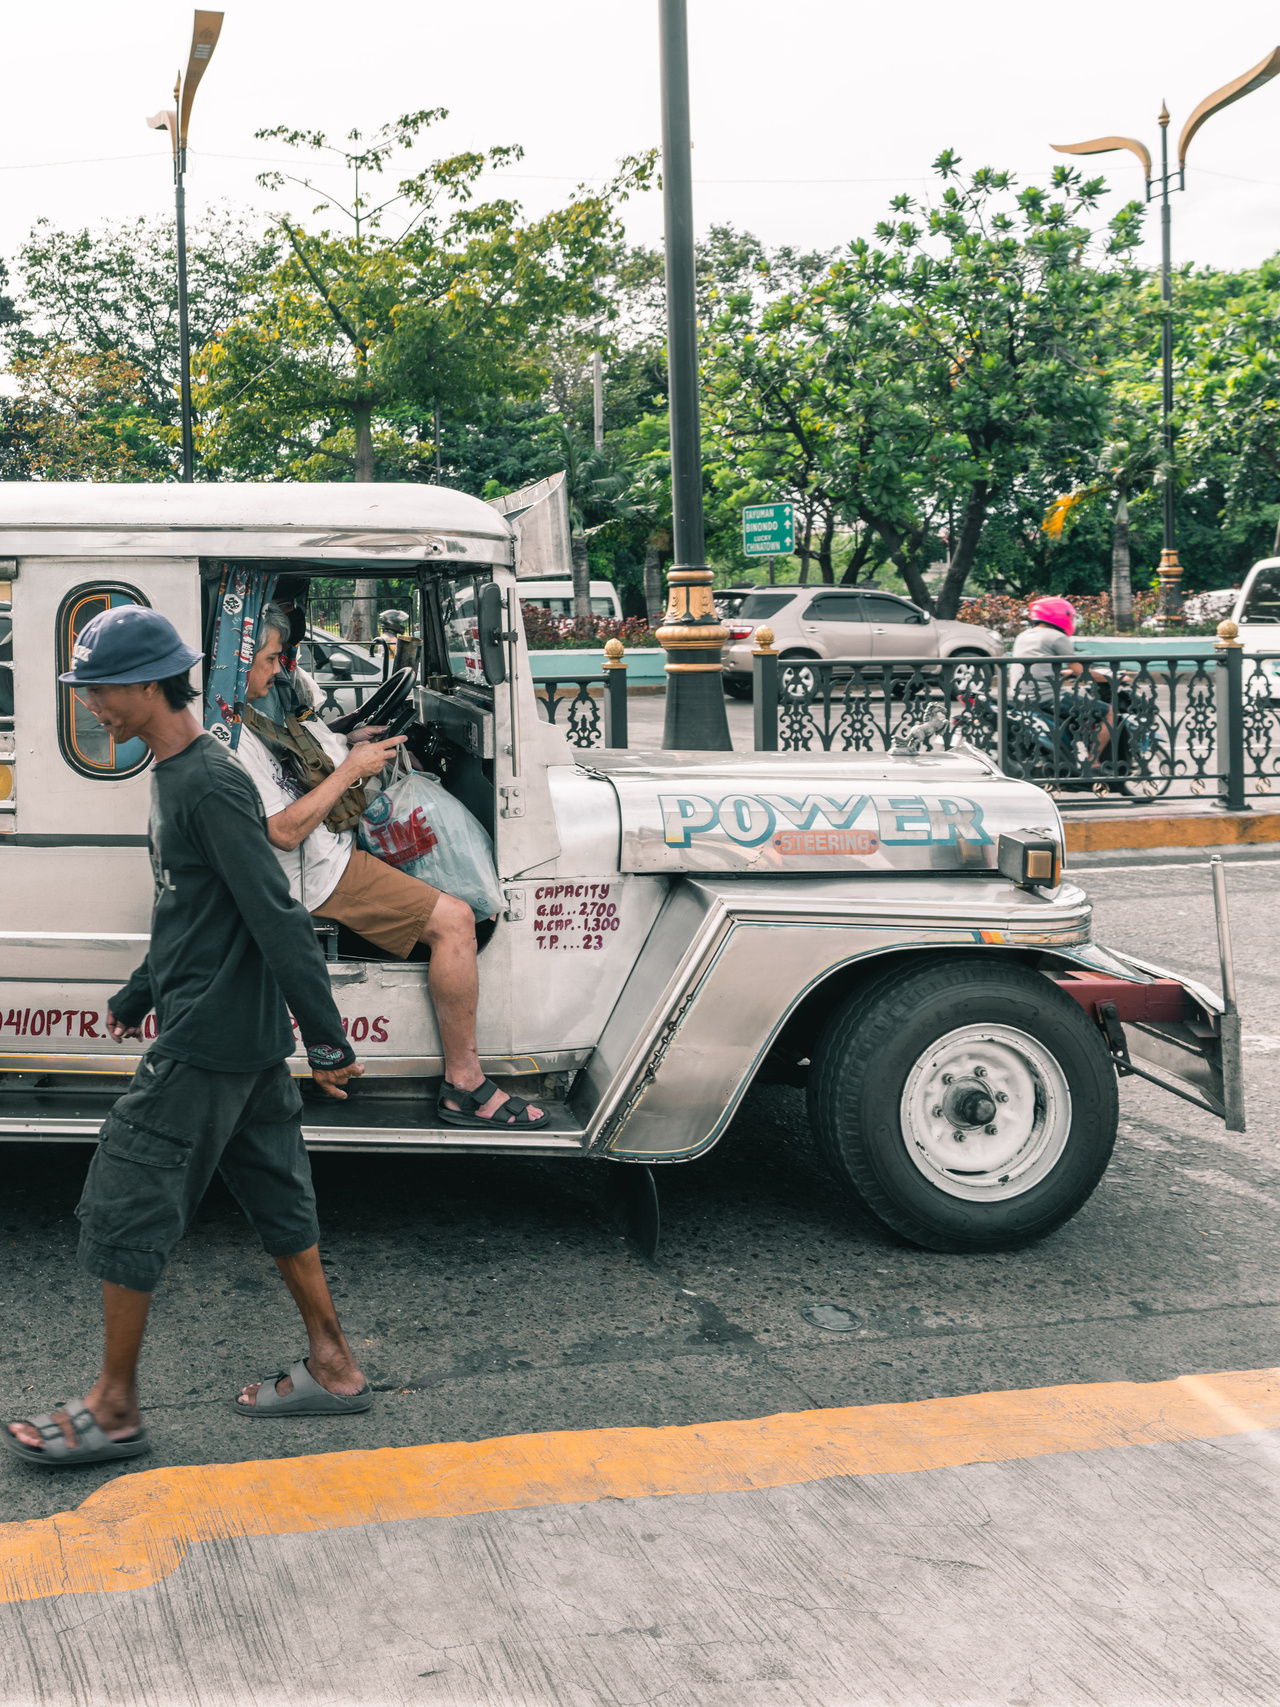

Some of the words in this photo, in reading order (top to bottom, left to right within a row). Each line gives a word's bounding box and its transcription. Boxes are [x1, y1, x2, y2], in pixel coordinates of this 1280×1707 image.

[745, 508, 775, 520] TAYUMAN
[745, 521, 778, 533] BINONDO
[753, 534, 772, 542] LUCKY
[746, 541, 781, 552] CHINATOWN
[657, 794, 996, 849] POWER
[780, 834, 871, 852] STEERING
[534, 884, 610, 900] CAPACITY
[582, 934, 604, 951] 23
